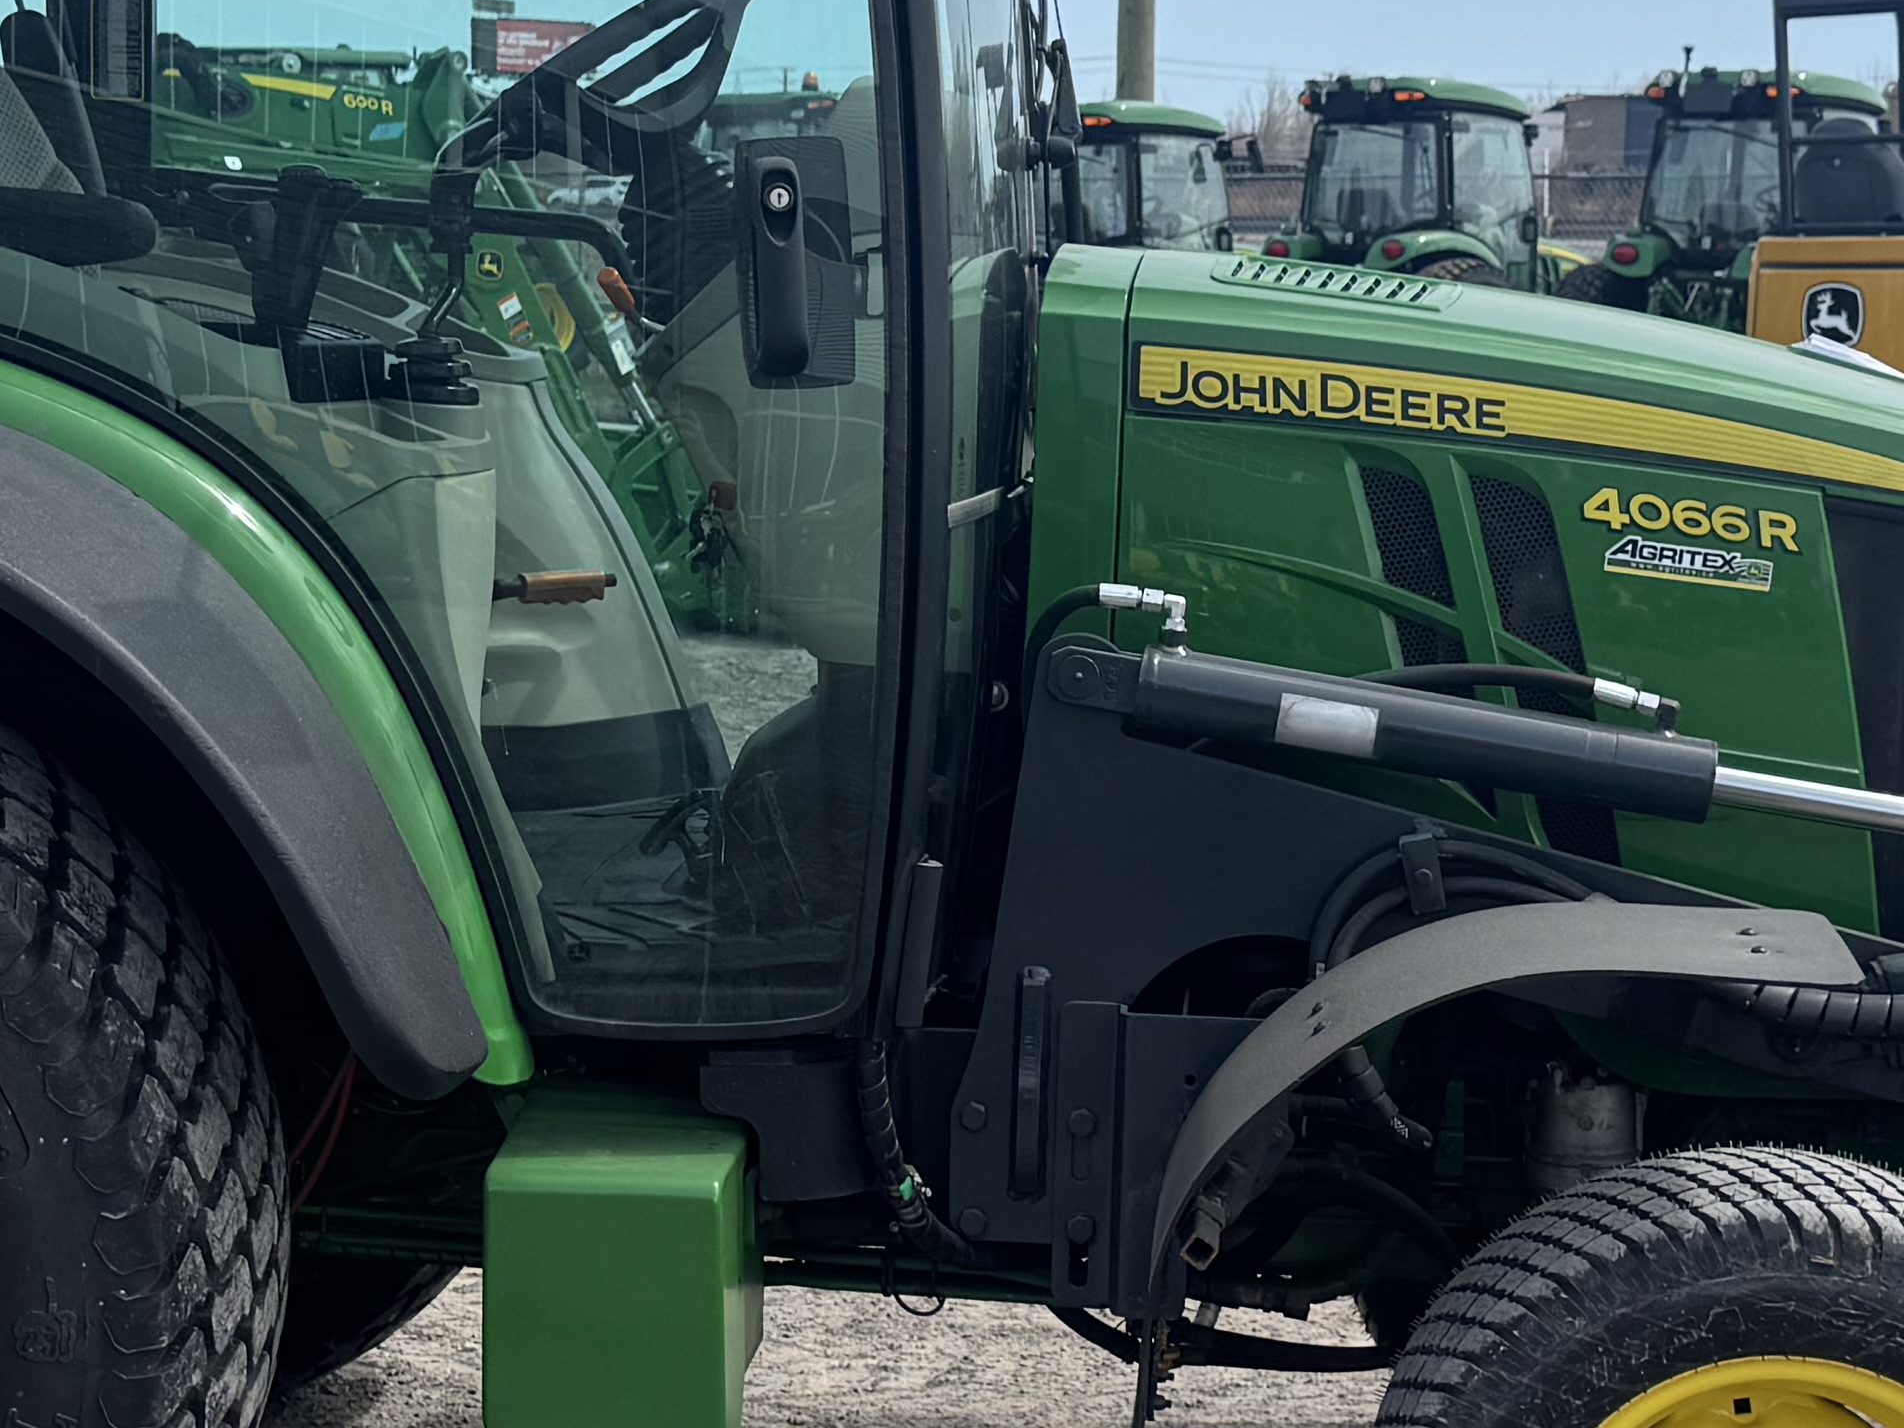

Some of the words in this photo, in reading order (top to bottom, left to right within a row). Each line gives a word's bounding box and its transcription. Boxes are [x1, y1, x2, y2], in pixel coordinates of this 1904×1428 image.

[1159, 360, 1307, 412] JOHN
[1320, 372, 1507, 432] DEERE
[1609, 537, 1738, 573] AGRITEX
